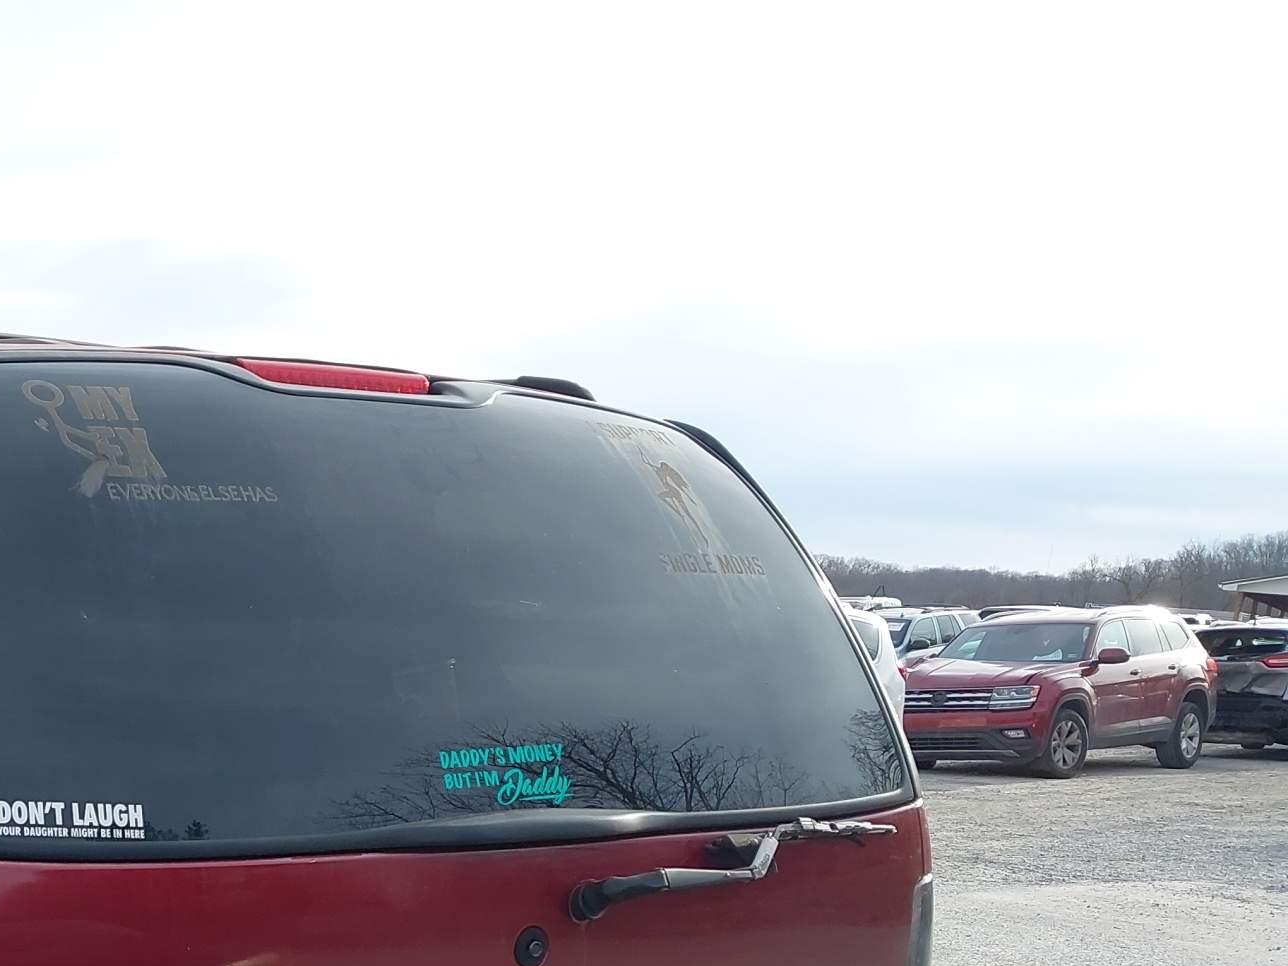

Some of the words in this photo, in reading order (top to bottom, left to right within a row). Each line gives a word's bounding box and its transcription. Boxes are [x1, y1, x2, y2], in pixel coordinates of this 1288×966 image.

[66, 385, 139, 421] MY
[199, 484, 242, 501] ELSE
[239, 485, 278, 502] HAS
[439, 747, 506, 769] DADDY'S
[508, 743, 563, 764] MONEY
[443, 773, 474, 789] BUT
[475, 771, 500, 787] I'M
[497, 766, 576, 806] Daddy
[72, 802, 145, 828] LAUGH
[23, 827, 69, 837] DAUGHTER
[70, 828, 98, 838] MIGHT
[100, 828, 112, 838] BE
[112, 829, 123, 839] IN
[124, 829, 145, 839] HERE
